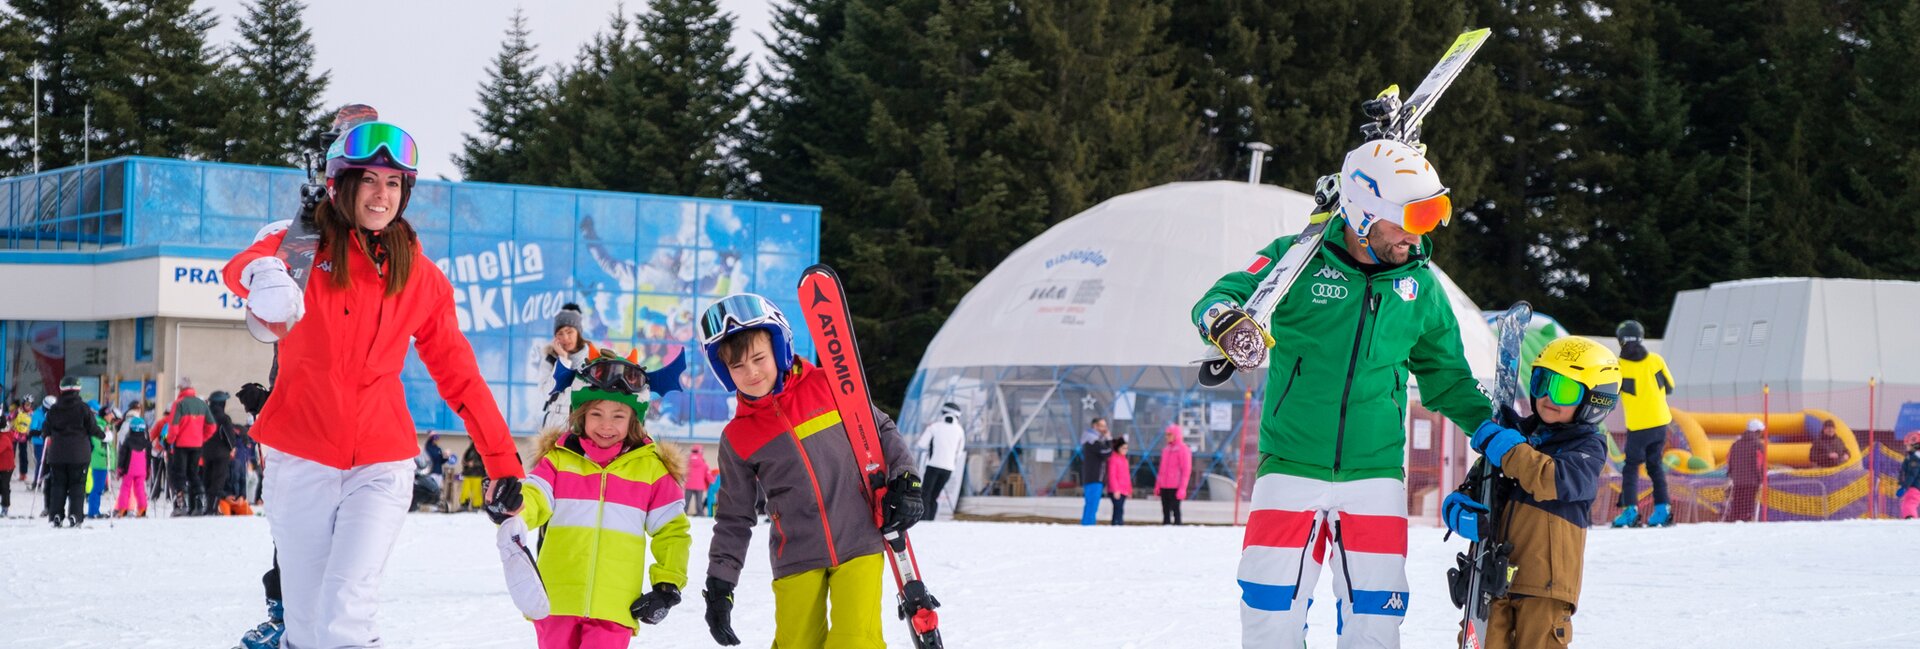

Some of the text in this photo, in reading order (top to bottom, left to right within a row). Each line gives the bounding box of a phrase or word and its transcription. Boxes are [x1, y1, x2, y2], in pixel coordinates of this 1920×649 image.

[174, 266, 223, 284] PRA
[522, 290, 564, 323] area
[817, 313, 855, 395] ATOMIC
[858, 424, 869, 451] REDSTER
